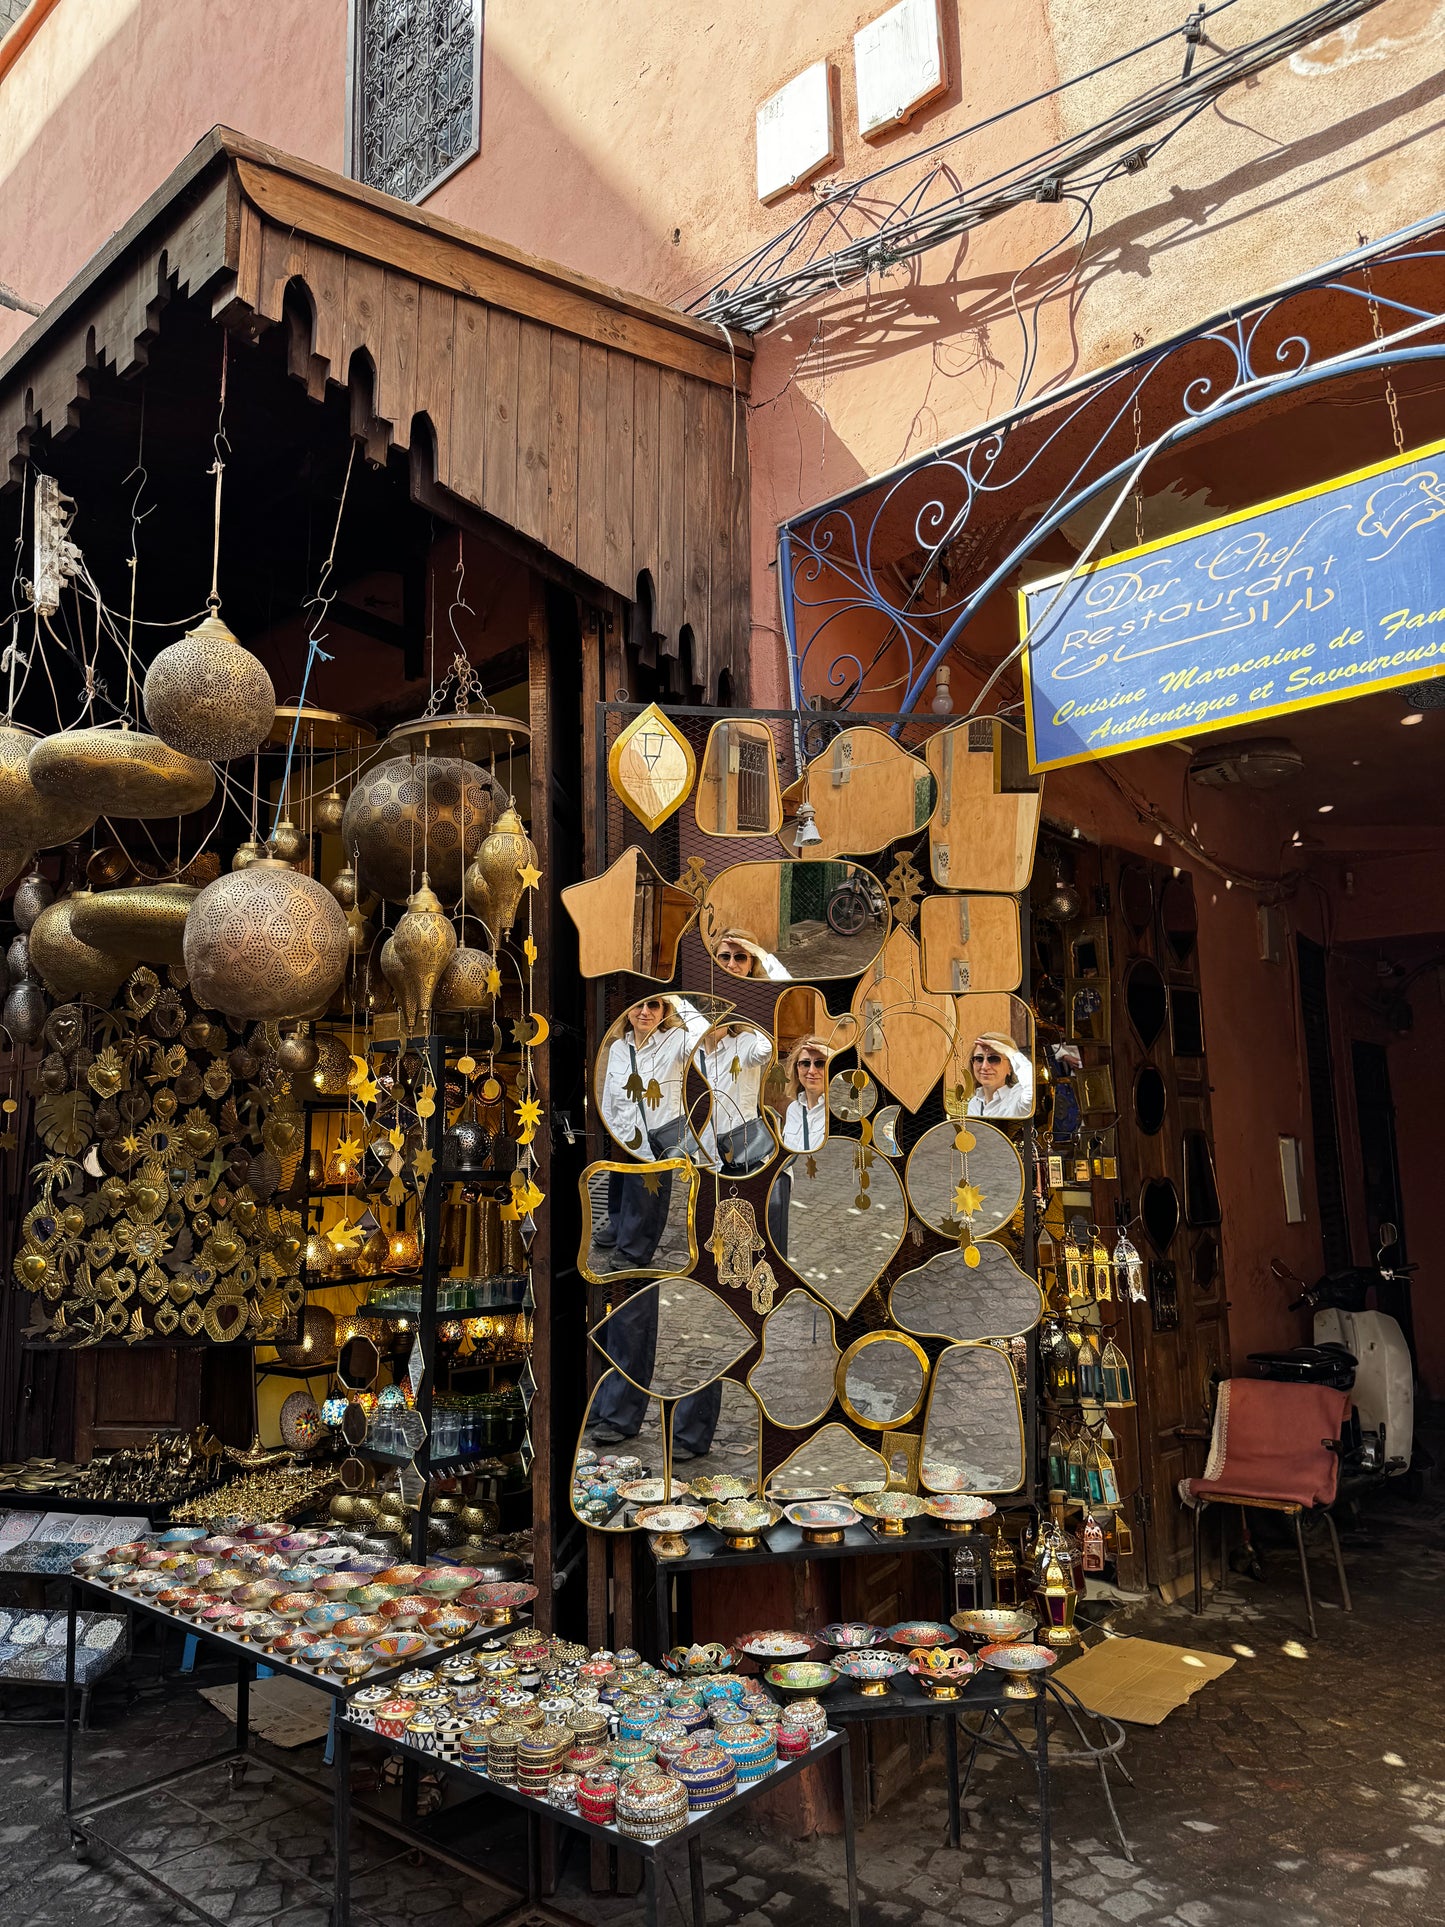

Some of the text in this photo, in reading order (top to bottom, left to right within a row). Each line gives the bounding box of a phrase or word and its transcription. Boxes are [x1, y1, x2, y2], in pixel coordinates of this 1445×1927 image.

[1061, 555, 1338, 654] Restaurant
[1085, 559, 1181, 618] Dar
[1195, 505, 1352, 580] Chef
[1274, 587, 1335, 629] دار
[1052, 688, 1147, 726] Cuisine
[1159, 643, 1316, 694] Marocaine
[1328, 627, 1365, 650] de
[1087, 692, 1240, 742] Authentique
[1249, 681, 1274, 703] et
